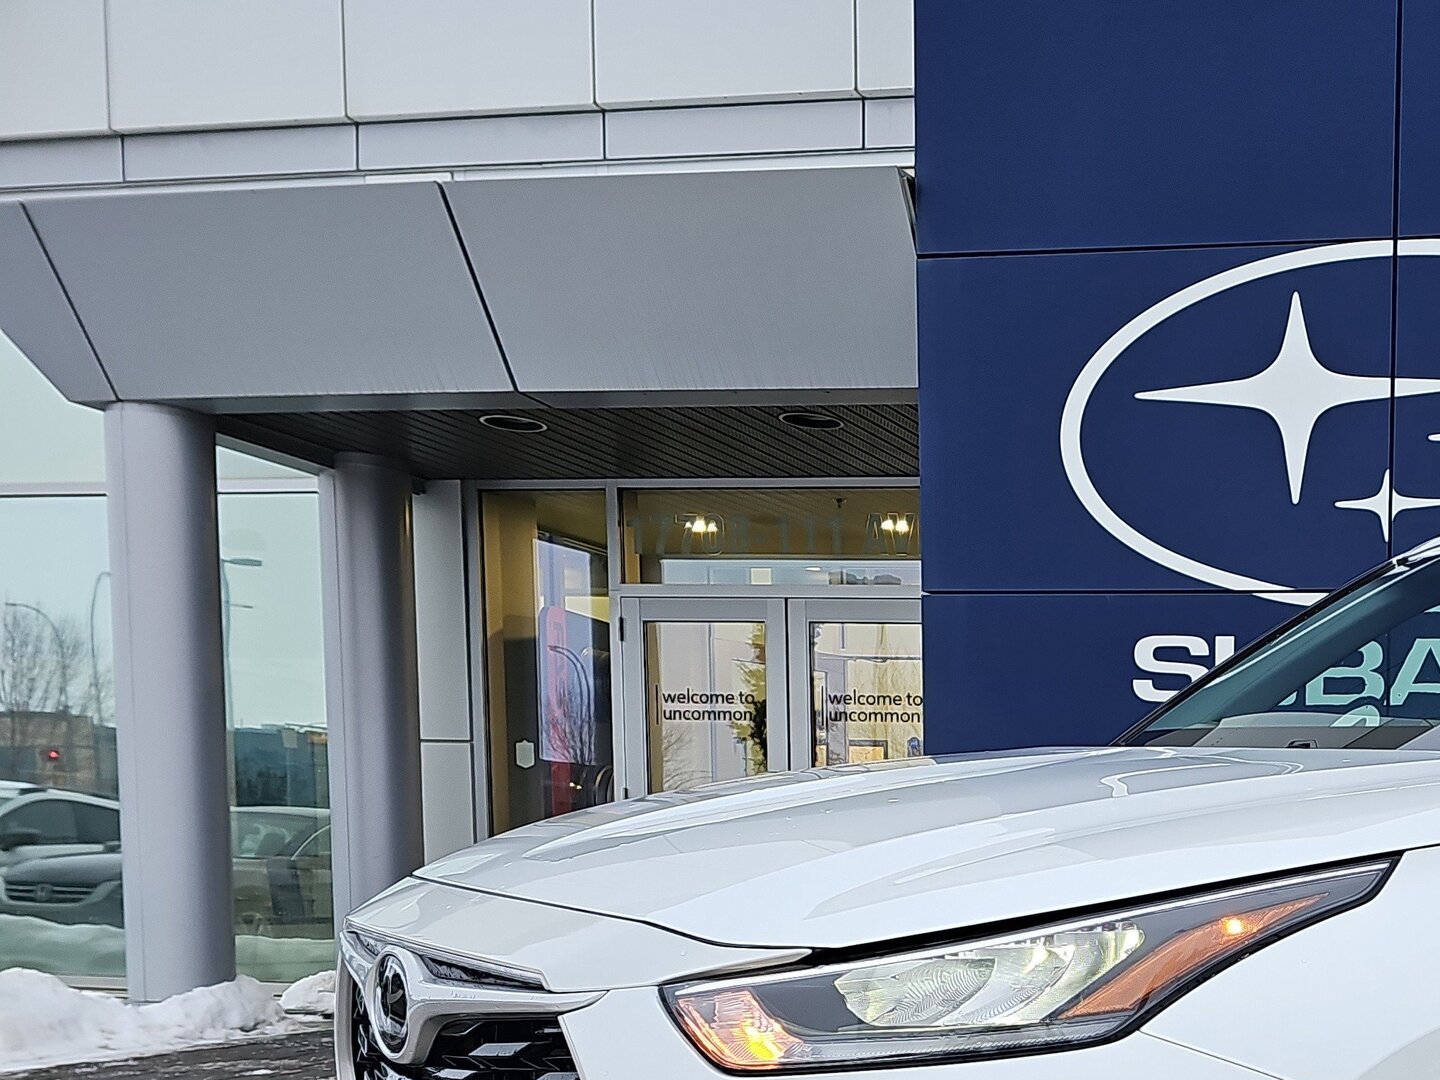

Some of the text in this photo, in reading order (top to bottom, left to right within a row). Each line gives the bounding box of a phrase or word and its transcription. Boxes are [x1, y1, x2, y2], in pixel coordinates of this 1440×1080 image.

[866, 511, 921, 556] AV
[662, 687, 755, 705] welcome to
[828, 688, 923, 706] welcome to
[663, 709, 753, 722] uncommon
[829, 710, 921, 723] uncommon
